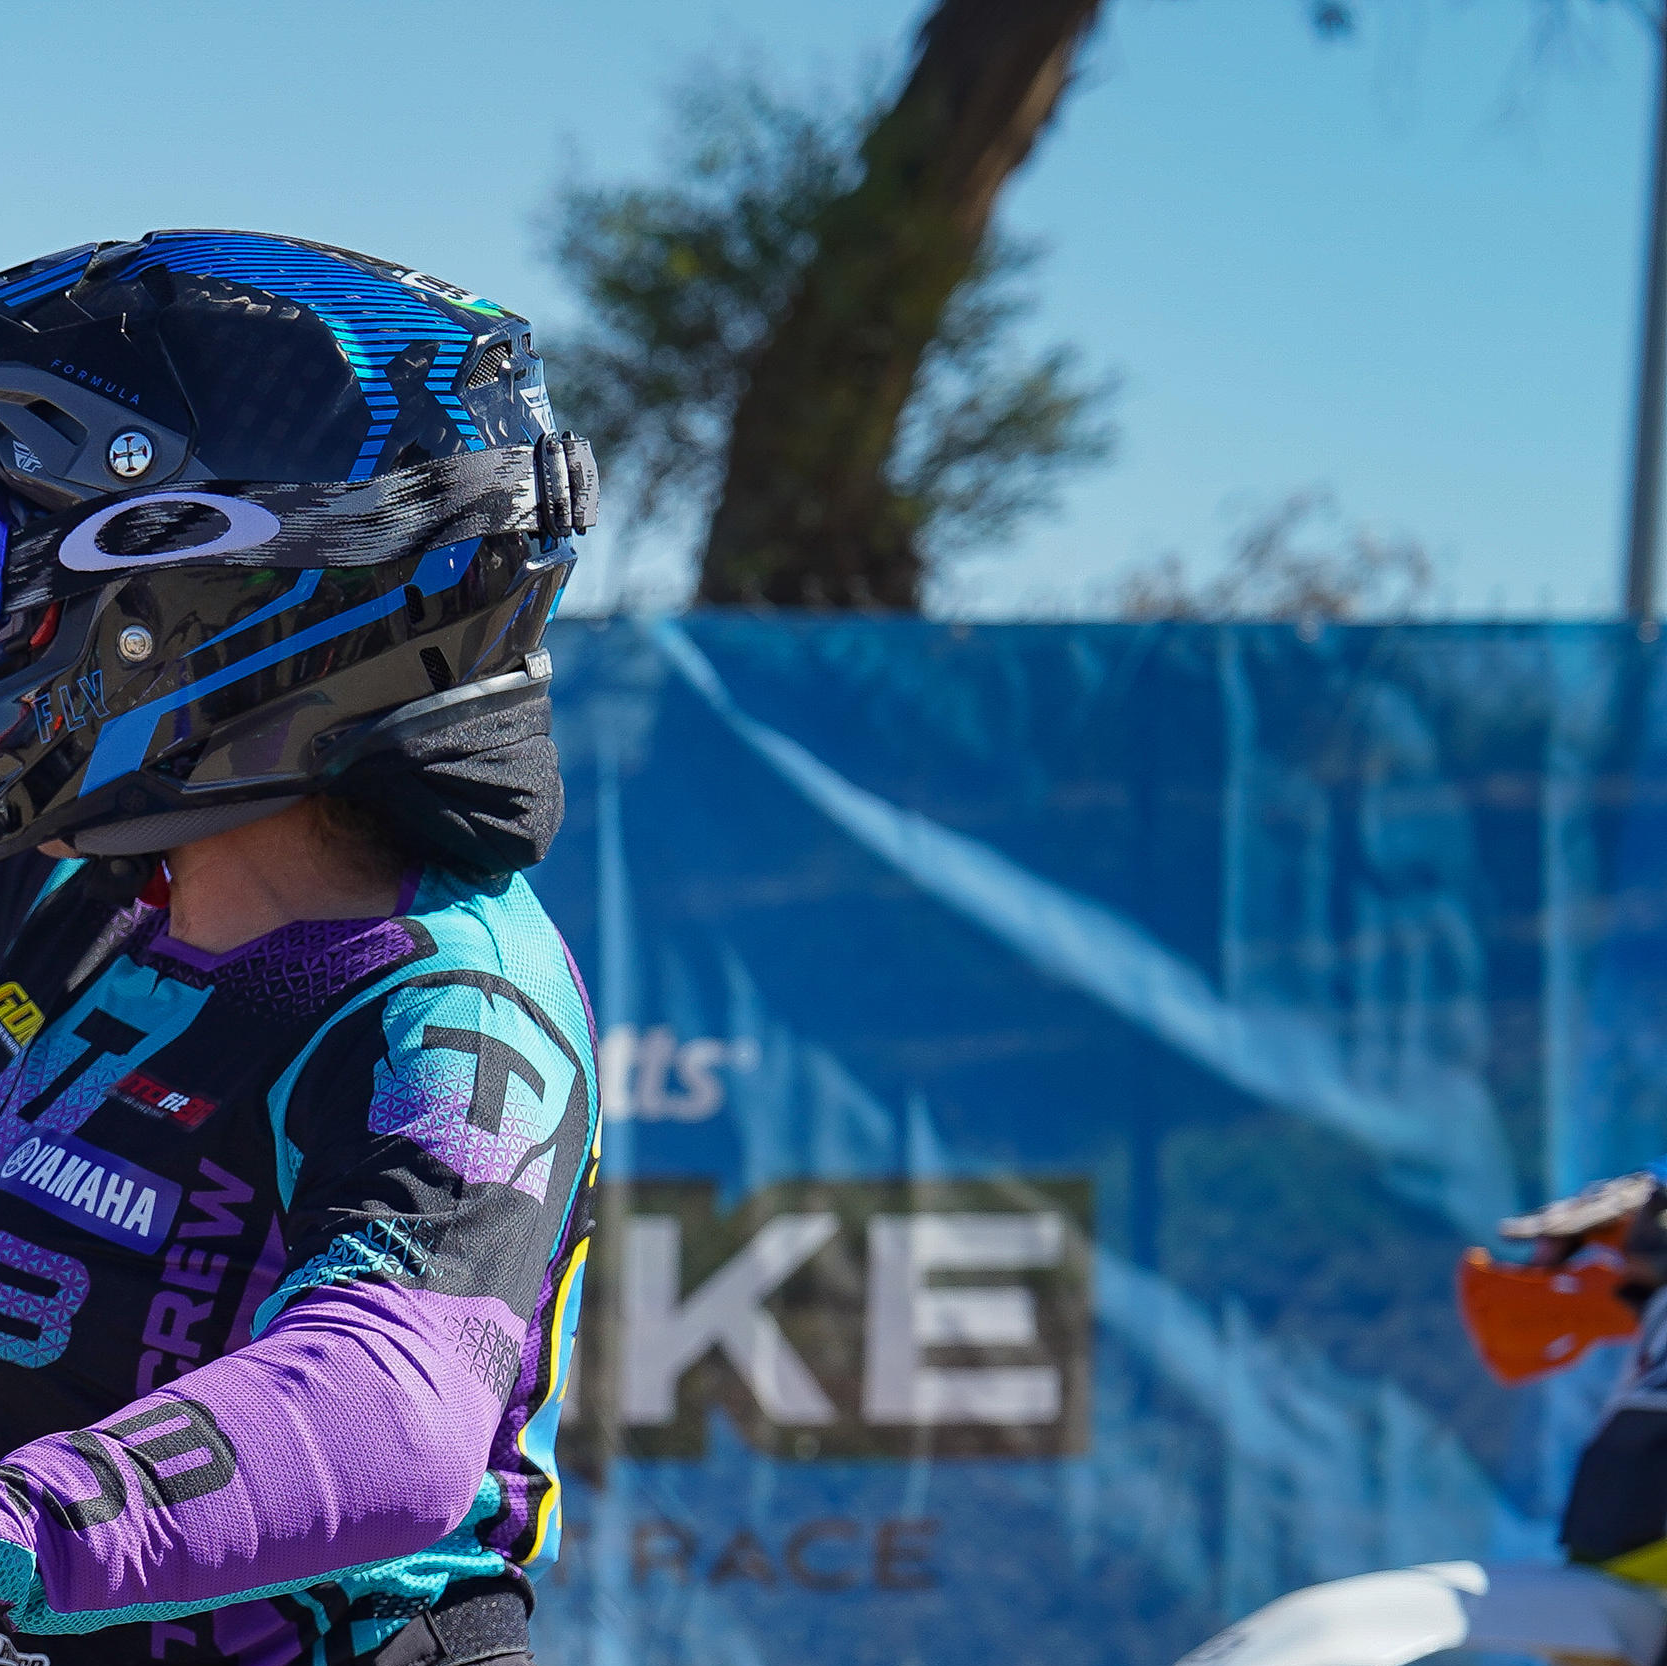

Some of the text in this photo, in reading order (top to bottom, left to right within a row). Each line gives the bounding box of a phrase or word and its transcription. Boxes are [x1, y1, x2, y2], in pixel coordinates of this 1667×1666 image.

[50, 357, 142, 406] FORMULA
[33, 668, 107, 746] FLY
[21, 1143, 157, 1238] YAMAHA
[135, 1157, 255, 1398] CREW
